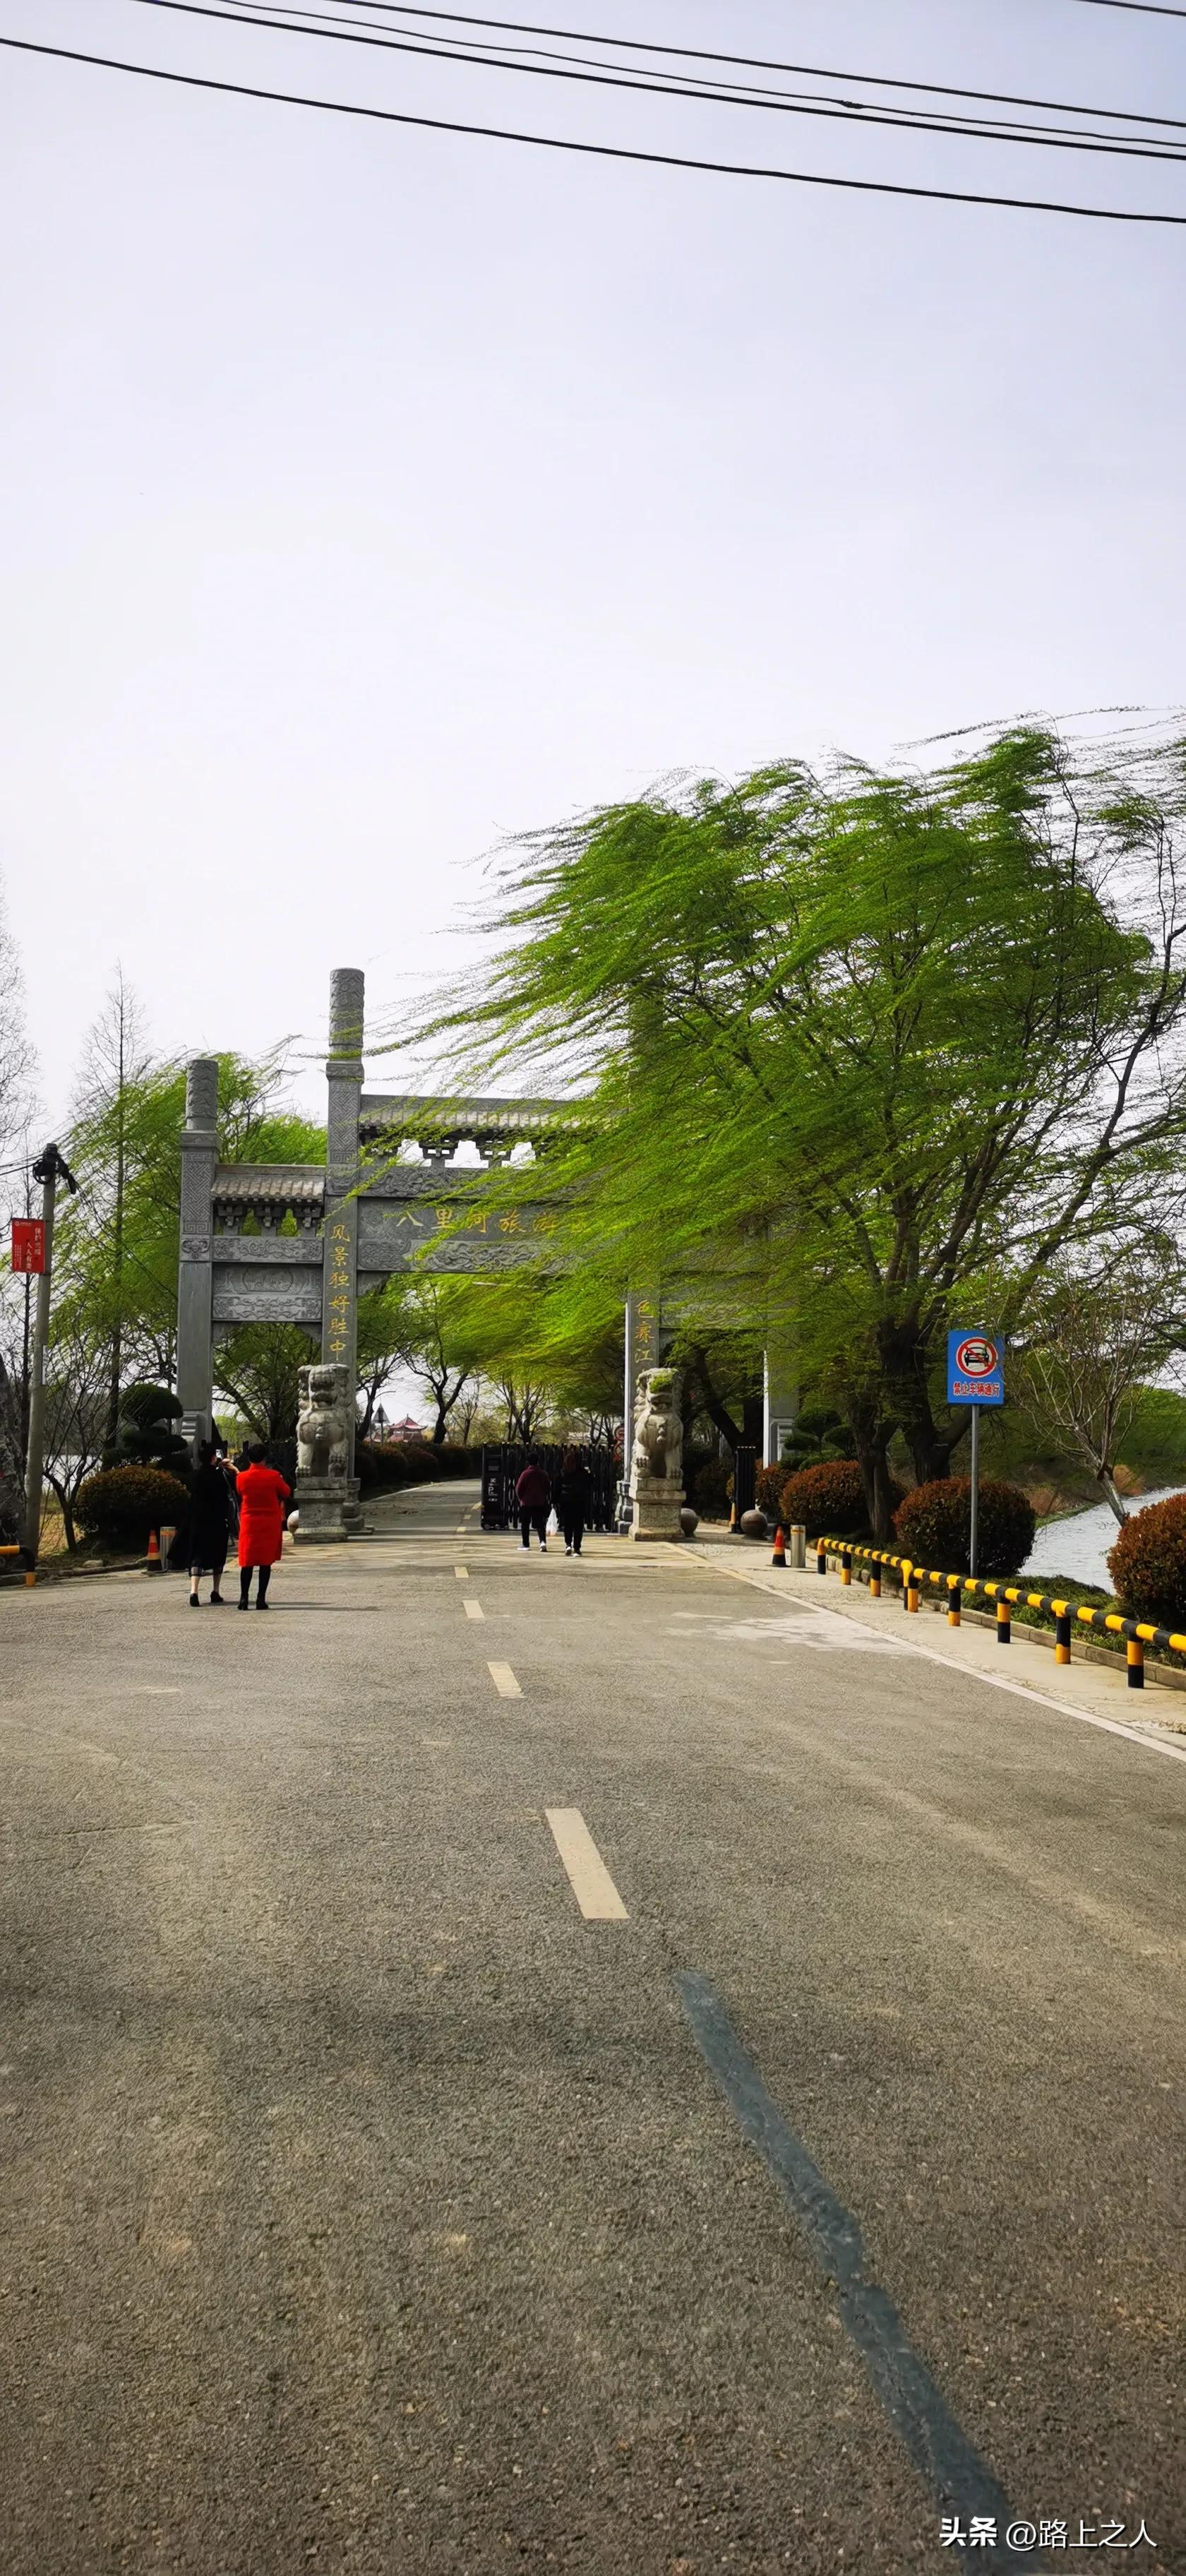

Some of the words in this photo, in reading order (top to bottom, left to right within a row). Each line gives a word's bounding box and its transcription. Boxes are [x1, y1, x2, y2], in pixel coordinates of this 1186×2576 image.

[328, 1224, 351, 1361] 风景独好胜中
[634, 1299, 655, 1373] 色赛江
[953, 1381, 1000, 1397] 禁止车辆通行
